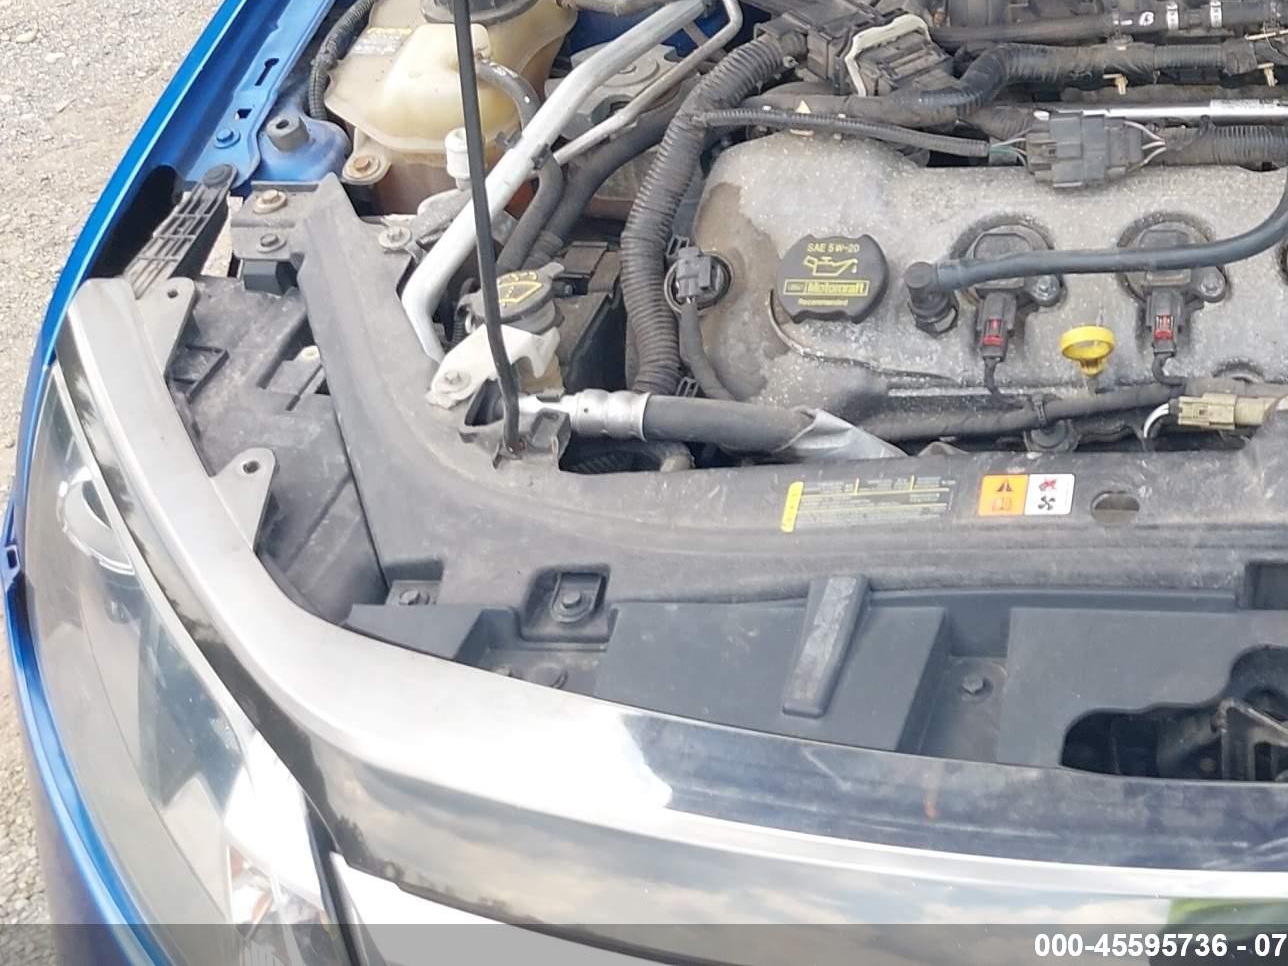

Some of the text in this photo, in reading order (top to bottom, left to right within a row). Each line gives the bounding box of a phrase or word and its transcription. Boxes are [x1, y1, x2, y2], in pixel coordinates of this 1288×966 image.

[807, 242, 861, 254] SAE 5W-20
[806, 280, 866, 295] Motorcraft
